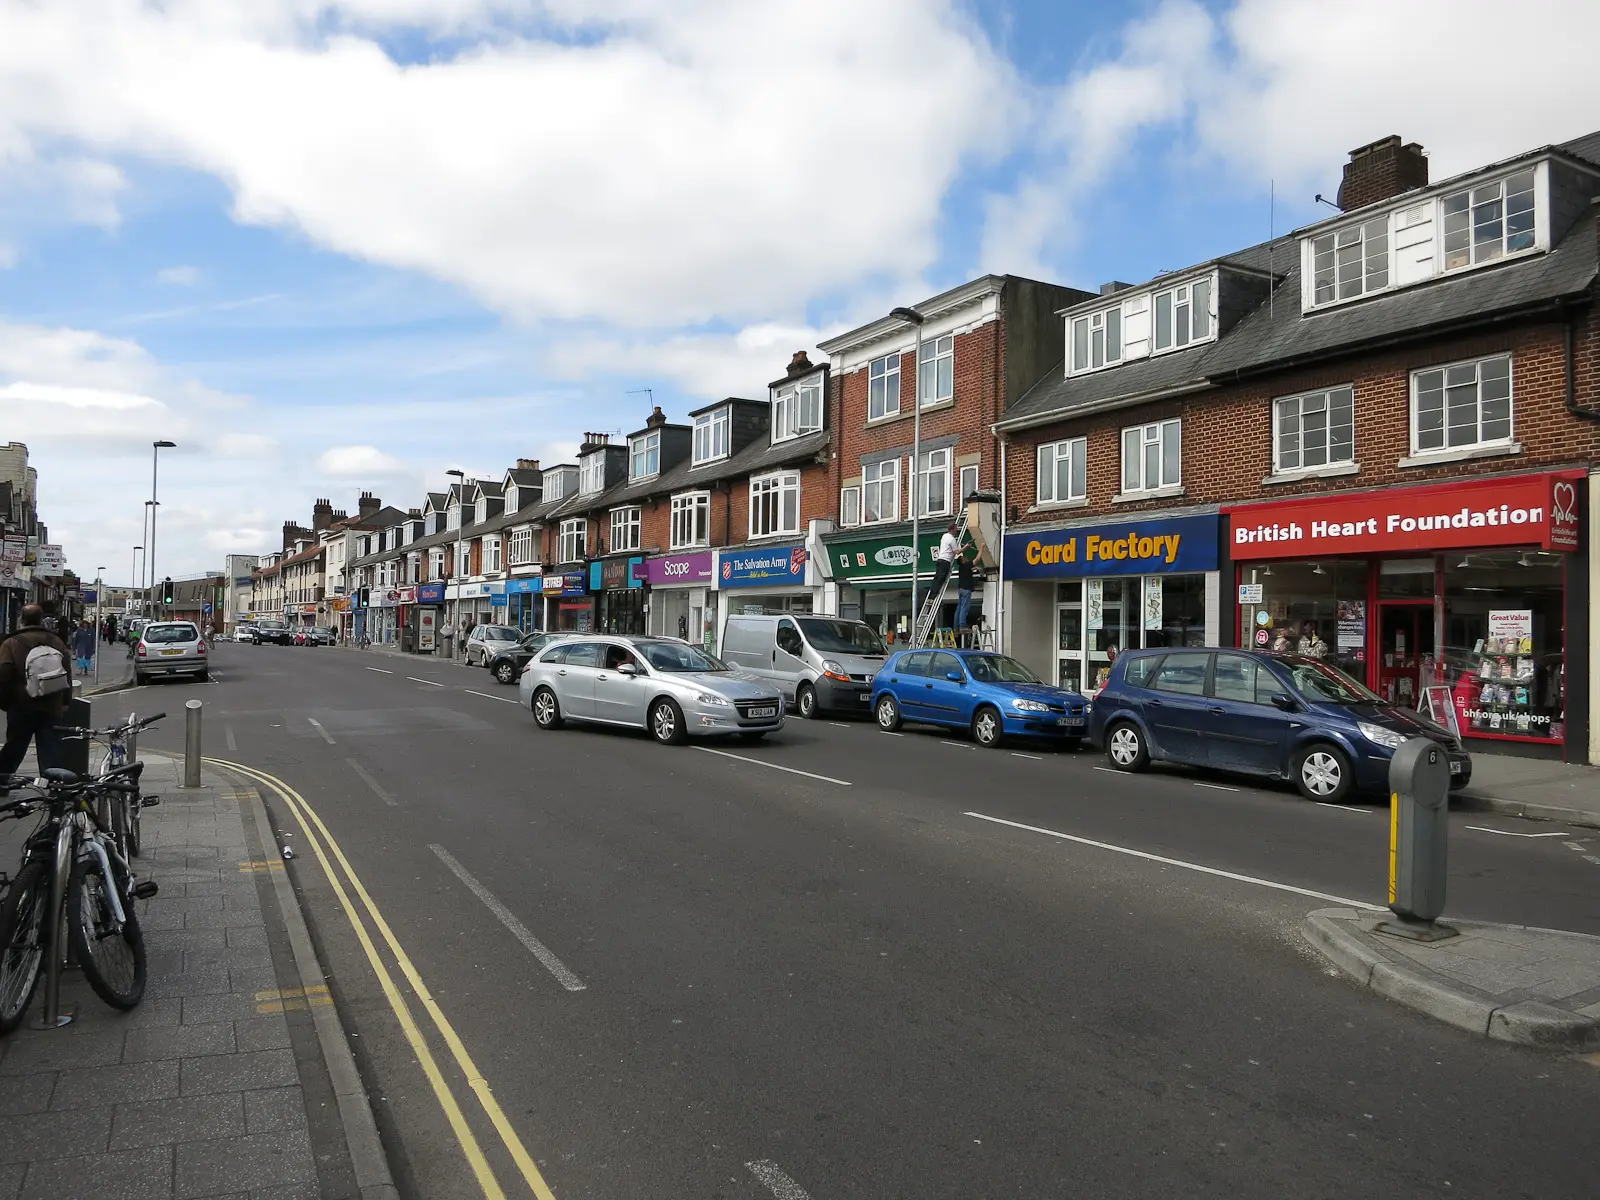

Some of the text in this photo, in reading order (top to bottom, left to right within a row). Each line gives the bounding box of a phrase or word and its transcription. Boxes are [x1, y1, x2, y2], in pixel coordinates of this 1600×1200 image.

[1235, 504, 1543, 544] British Heart Foundation
[1026, 532, 1181, 565] Card Factory
[1551, 535, 1577, 545] Foundation
[664, 560, 689, 578] Scope
[734, 556, 787, 571] The Salvation Army
[1462, 708, 1551, 725] bhf.org.uk/shops
[1429, 751, 1436, 763] 6
